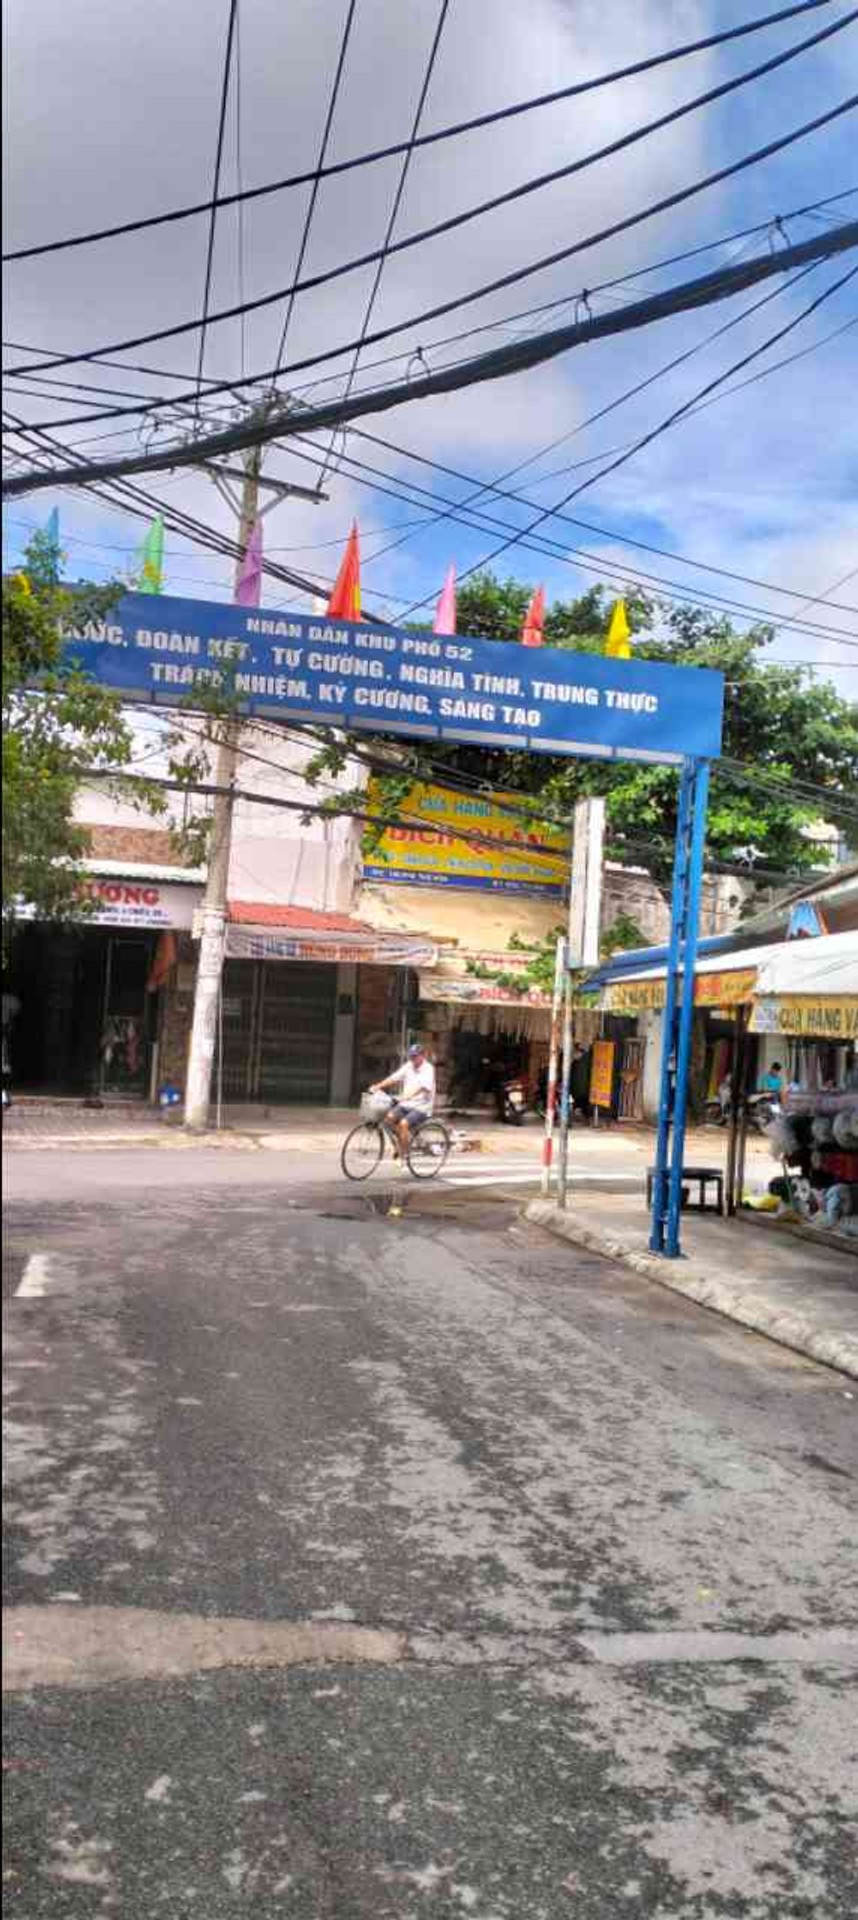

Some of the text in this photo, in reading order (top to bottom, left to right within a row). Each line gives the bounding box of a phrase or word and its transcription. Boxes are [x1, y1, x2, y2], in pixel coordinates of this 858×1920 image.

[246, 617, 474, 661] NHÂN DÂN KHU PHỐ 52
[271, 646, 303, 671] TỰ
[399, 663, 465, 690] NGHĨA
[530, 681, 599, 706] TRUNG
[605, 689, 658, 713] THỰC
[439, 696, 495, 721] SÁNG
[501, 706, 541, 729] TẠO
